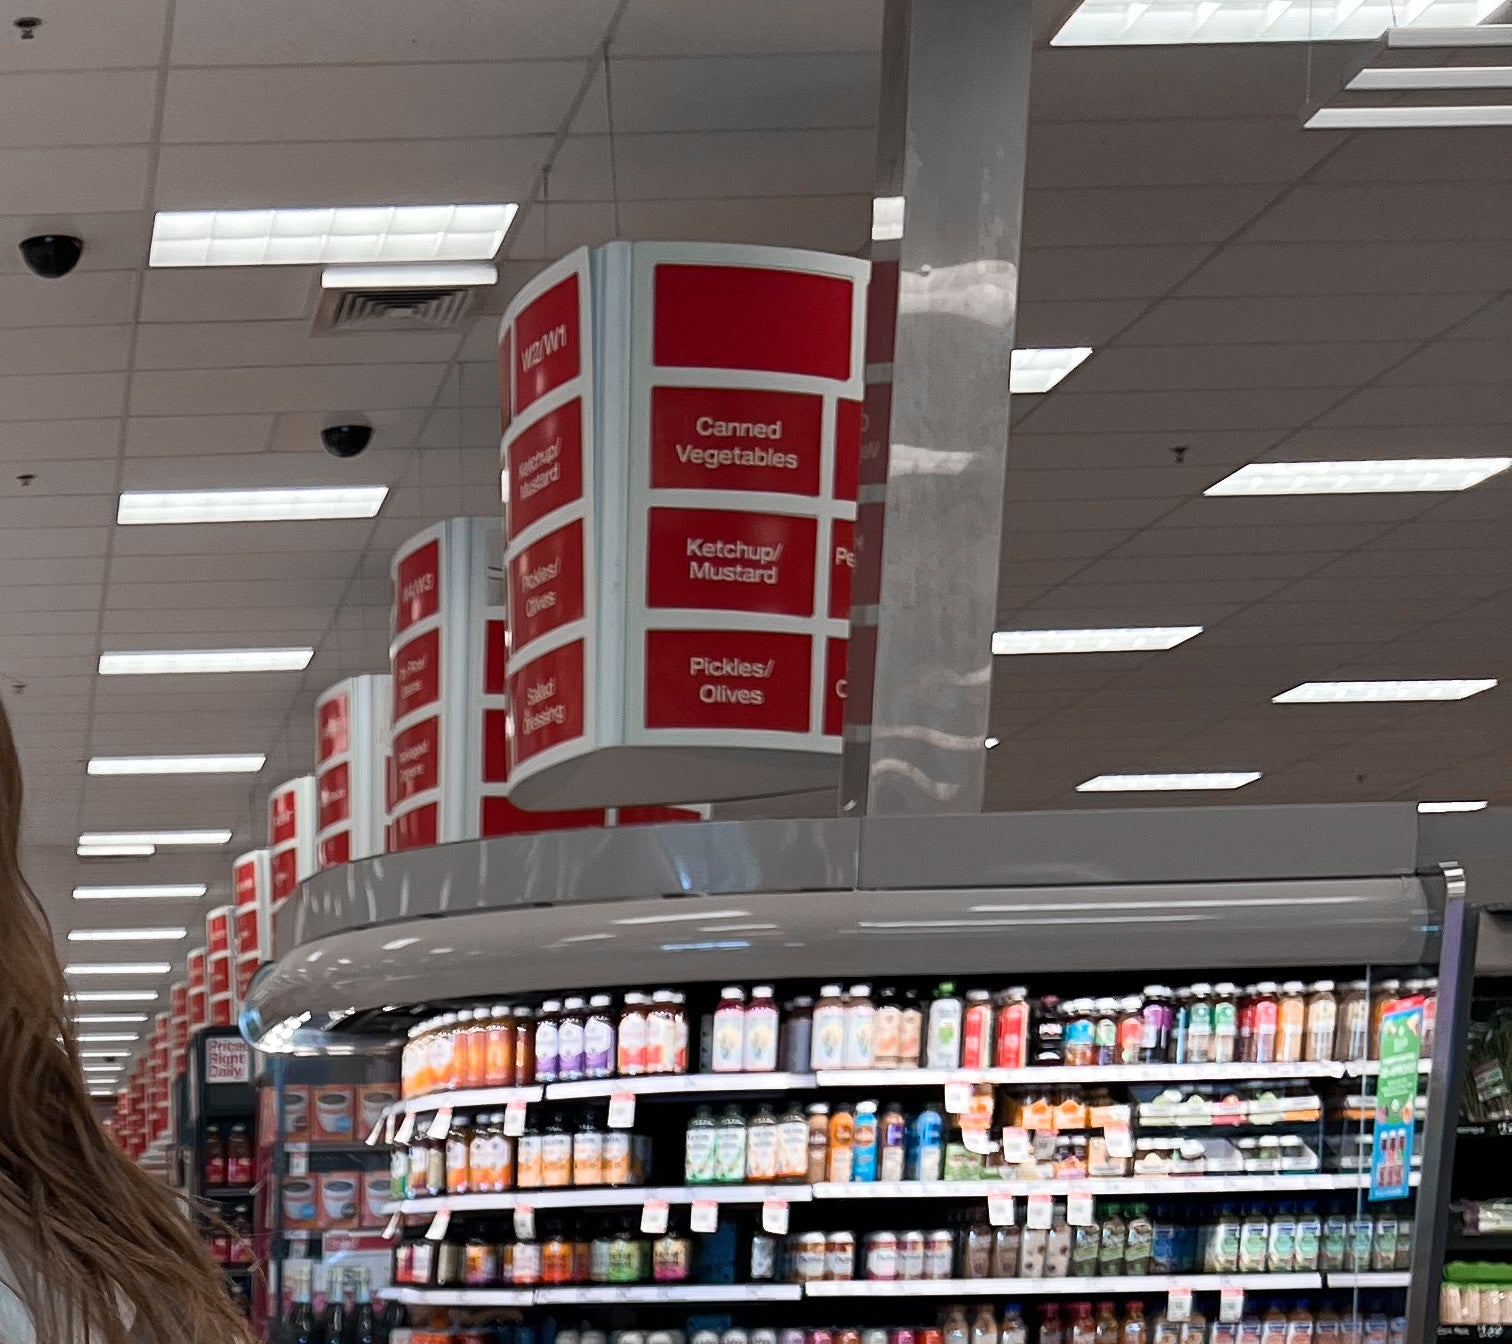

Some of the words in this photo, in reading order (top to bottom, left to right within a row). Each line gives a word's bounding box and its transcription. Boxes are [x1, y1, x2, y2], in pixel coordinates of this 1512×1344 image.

[696, 416, 783, 441] Canned
[675, 444, 800, 471] Vegetables
[687, 538, 782, 563] Ketchup/
[689, 561, 779, 585] Mustard
[689, 656, 774, 680] Pickles/
[699, 682, 765, 706] Olives
